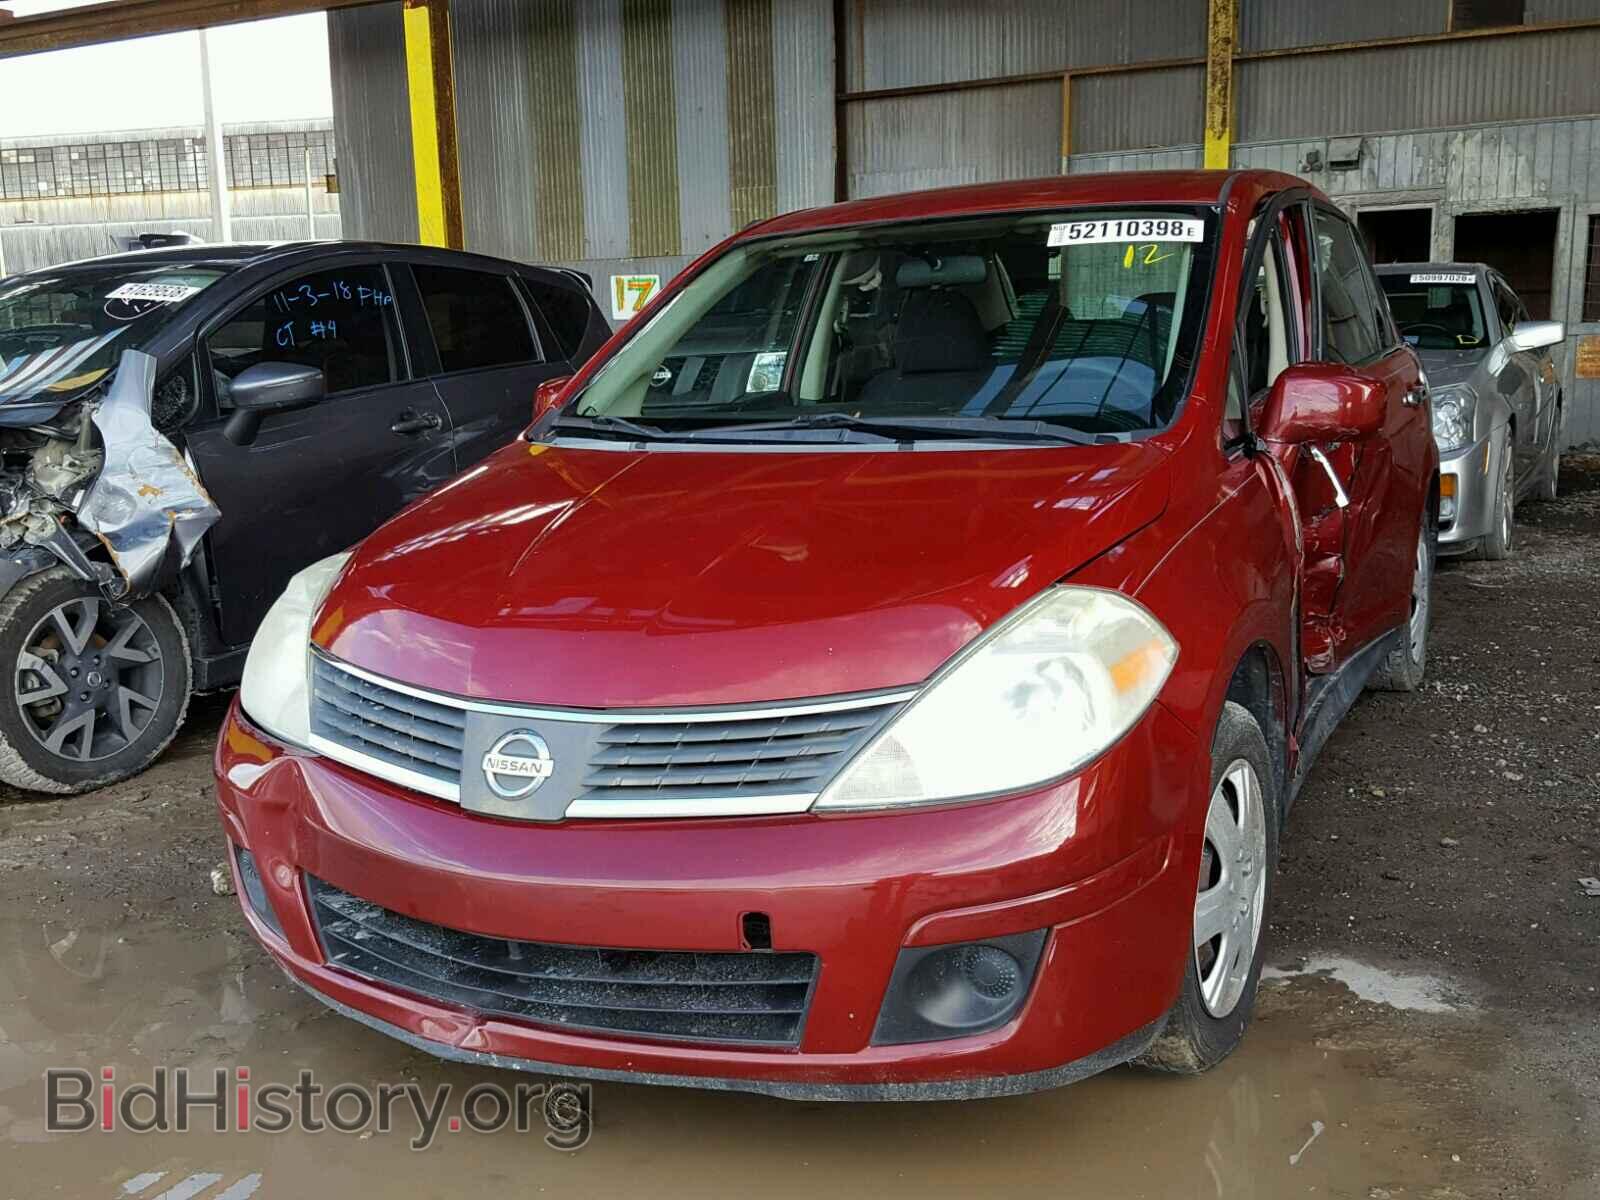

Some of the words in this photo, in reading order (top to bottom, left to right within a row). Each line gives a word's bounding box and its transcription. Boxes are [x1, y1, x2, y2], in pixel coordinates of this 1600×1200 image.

[1068, 221, 1184, 240] 52110398
[1187, 227, 1196, 237] E
[1123, 244, 1175, 268] 12
[273, 280, 352, 312] 11-3-18
[615, 276, 657, 312] 17
[276, 321, 296, 347] CT
[310, 319, 337, 339] #4
[487, 757, 542, 773] NISSAN
